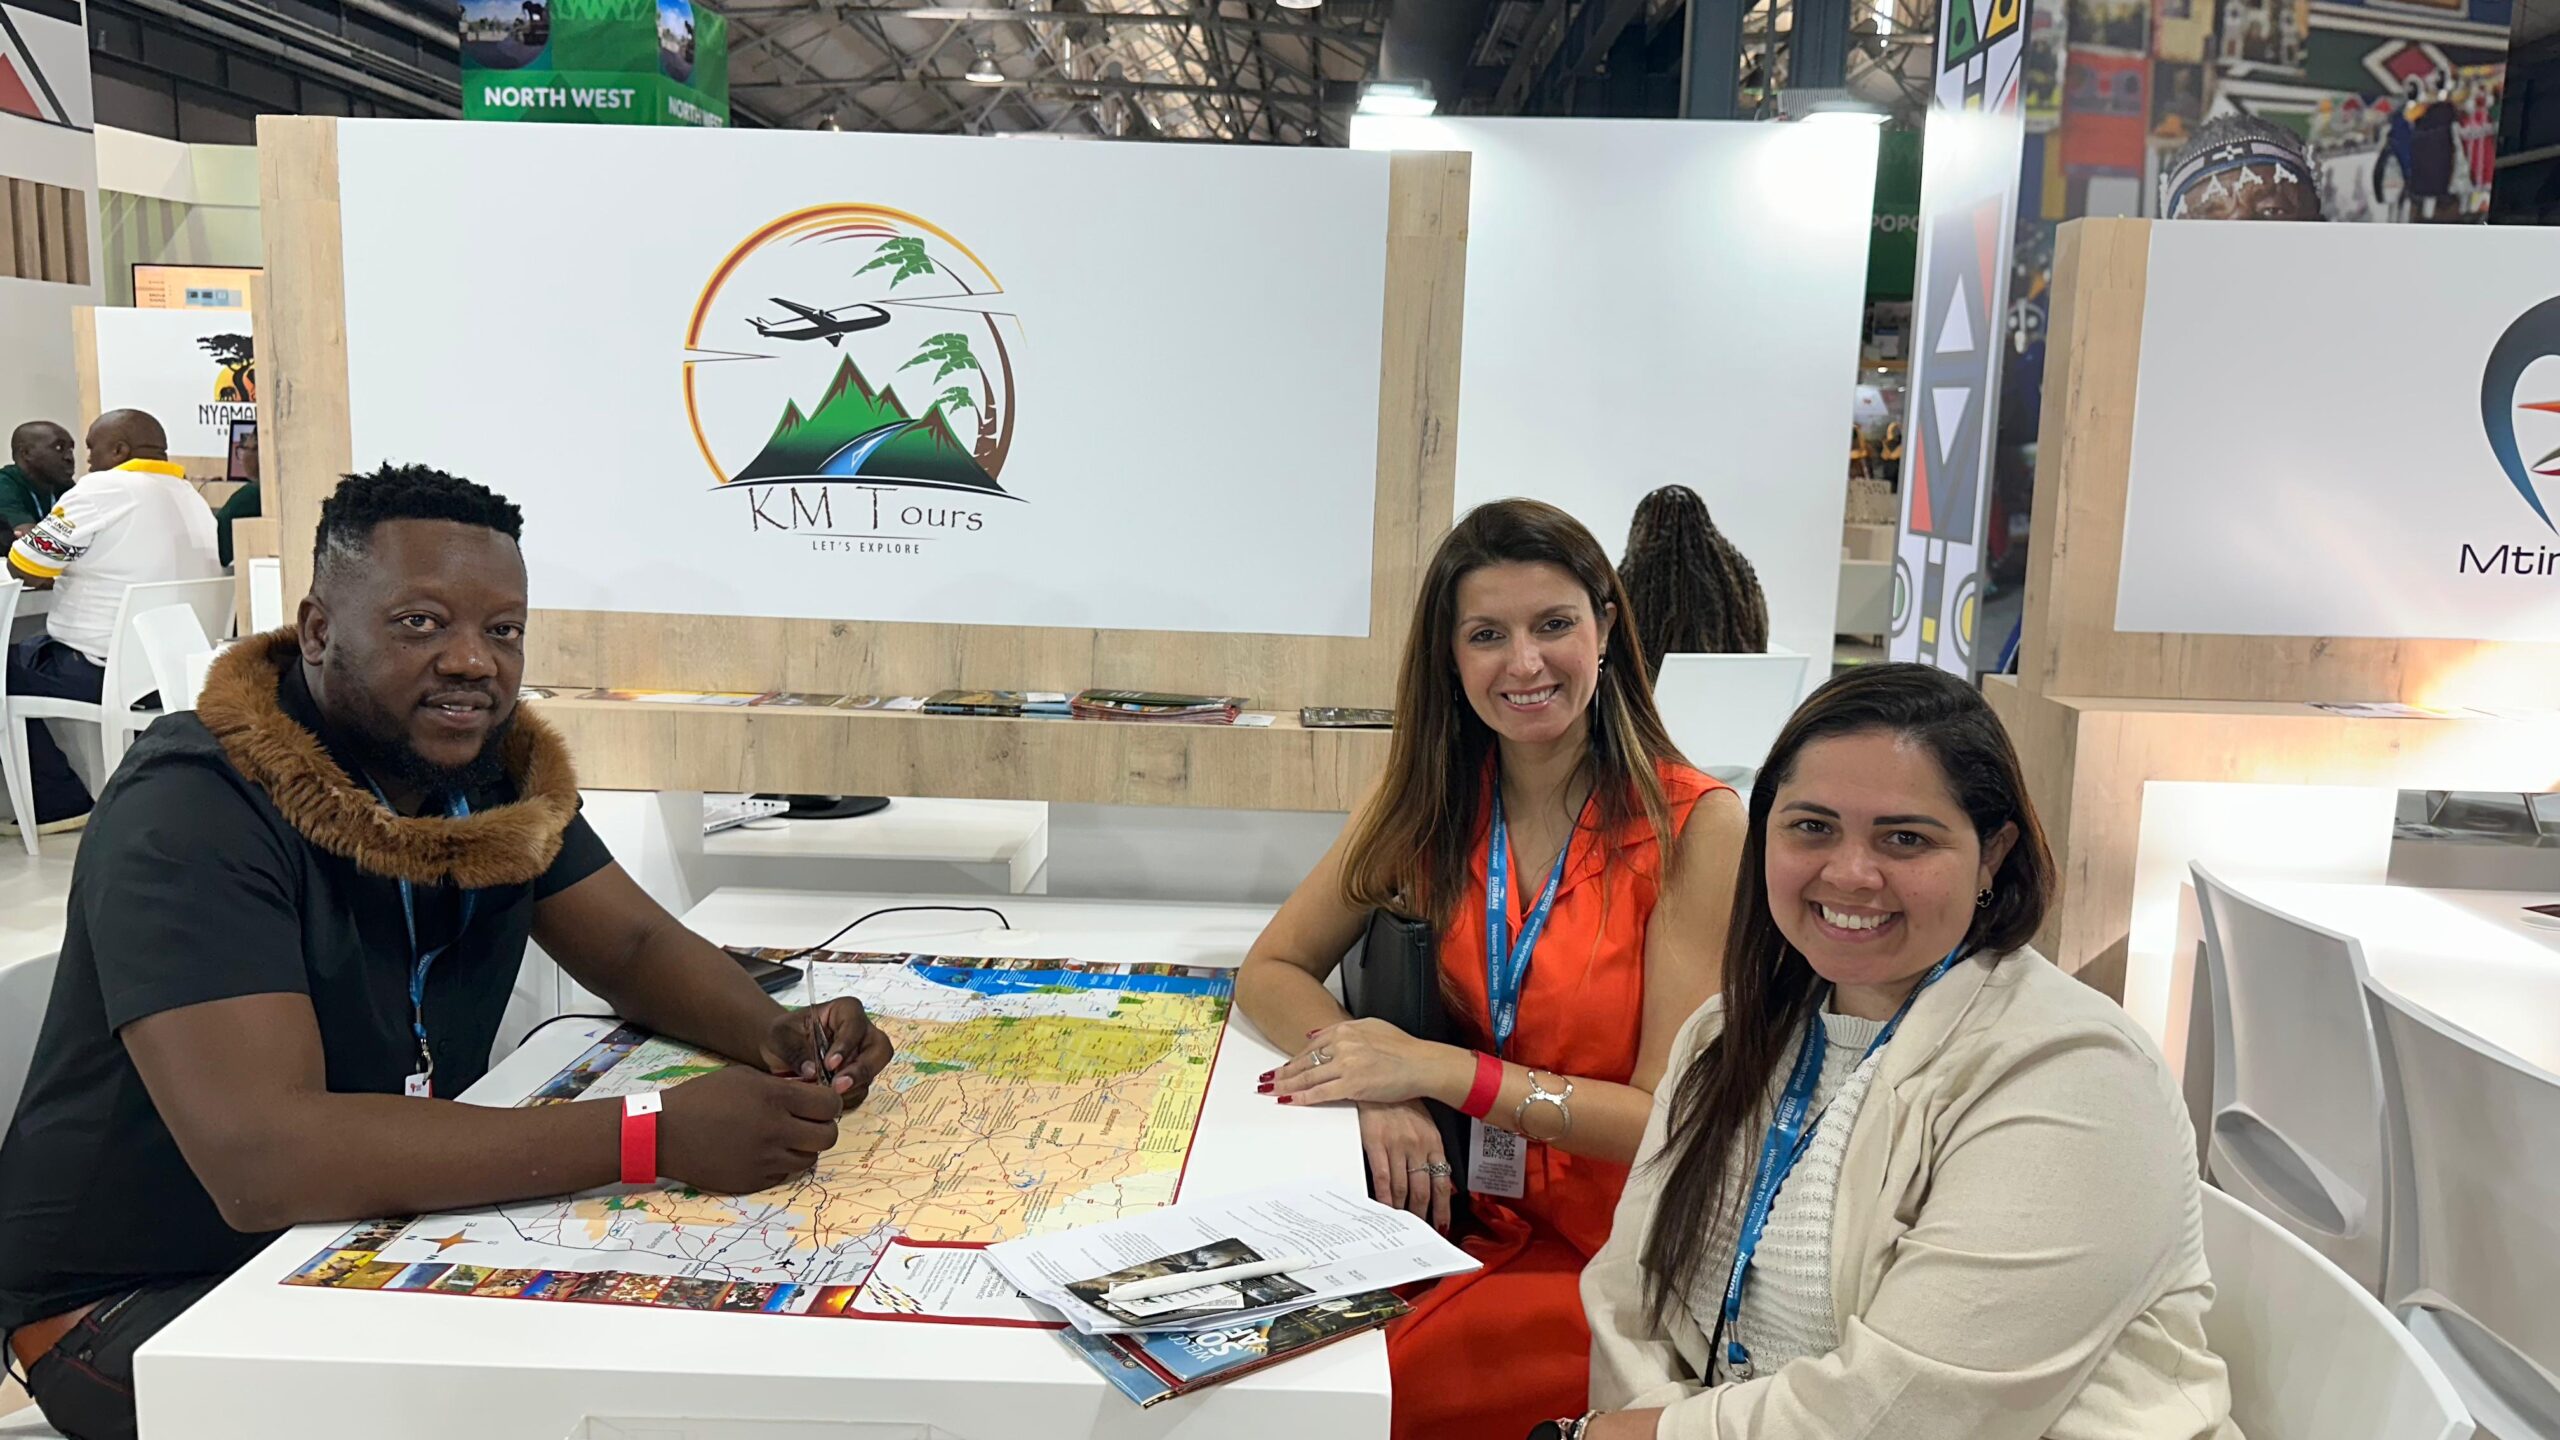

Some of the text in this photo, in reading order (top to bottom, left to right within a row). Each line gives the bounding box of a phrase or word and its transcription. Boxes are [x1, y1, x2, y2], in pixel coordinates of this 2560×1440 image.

[484, 87, 636, 109] NORTH WEST
[668, 96, 702, 123] NORTH
[199, 404, 257, 425] NYAMA
[748, 486, 984, 532] KM Tours
[812, 540, 921, 555] LET'S EXPLORE
[1491, 876, 1499, 910] DURBAN
[1540, 879, 1557, 912] DURBAN
[1491, 923, 1499, 955] Welcome
[1491, 956, 1498, 964] to
[1491, 964, 1500, 990] Durban
[1499, 1003, 1512, 1037] DURBAN
[1777, 1096, 1797, 1132] DURBAN
[1753, 1148, 1777, 1208] Welcome to
[1726, 1251, 1746, 1299] DURBAN
[1168, 1333, 1212, 1363] WELCO
